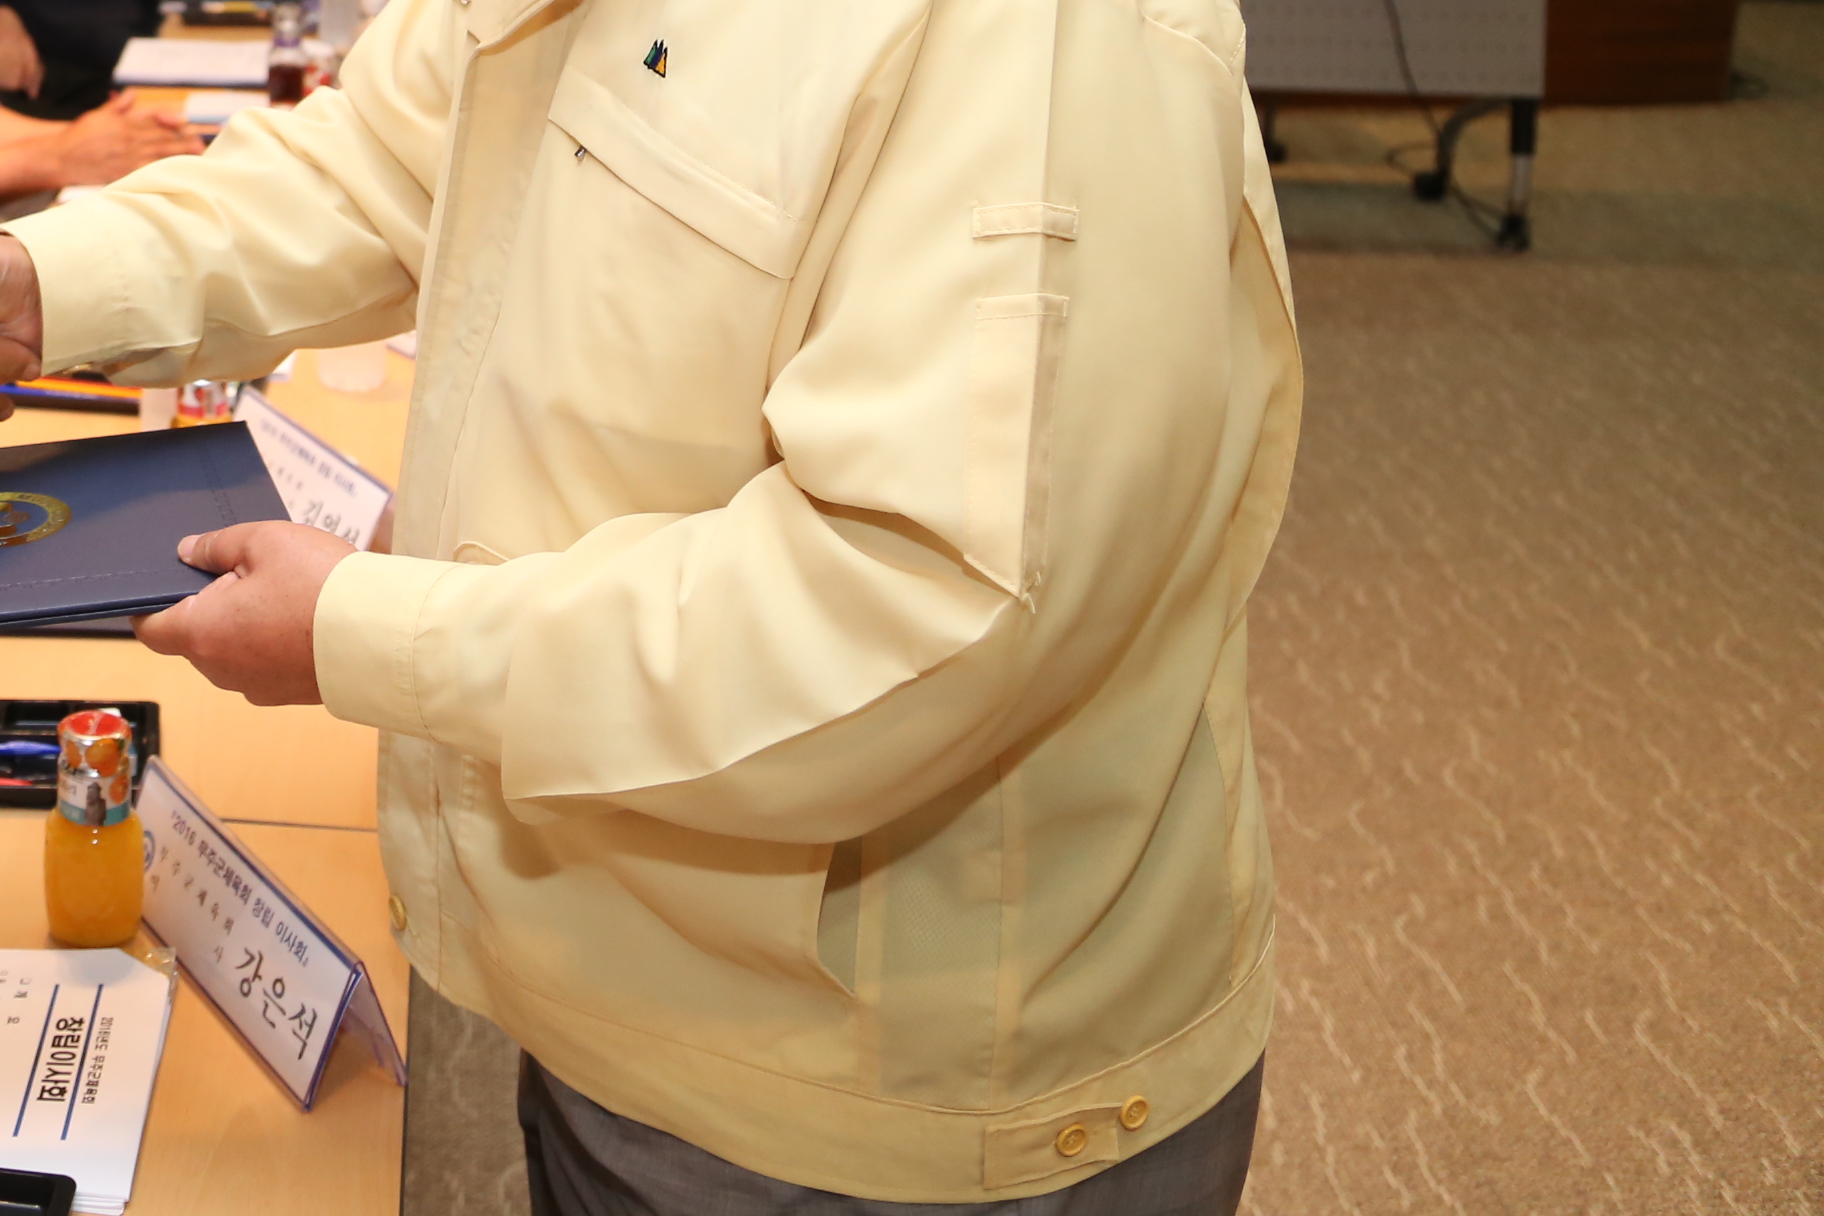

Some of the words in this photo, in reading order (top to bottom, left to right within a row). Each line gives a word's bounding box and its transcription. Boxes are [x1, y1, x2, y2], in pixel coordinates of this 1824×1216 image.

[198, 840, 253, 904] 무주군체육회
[252, 896, 275, 929] 창립
[235, 947, 318, 1061] 강은석
[37, 1017, 85, 1102] 창립이사회
[82, 1055, 105, 1104] 무주군체육회
